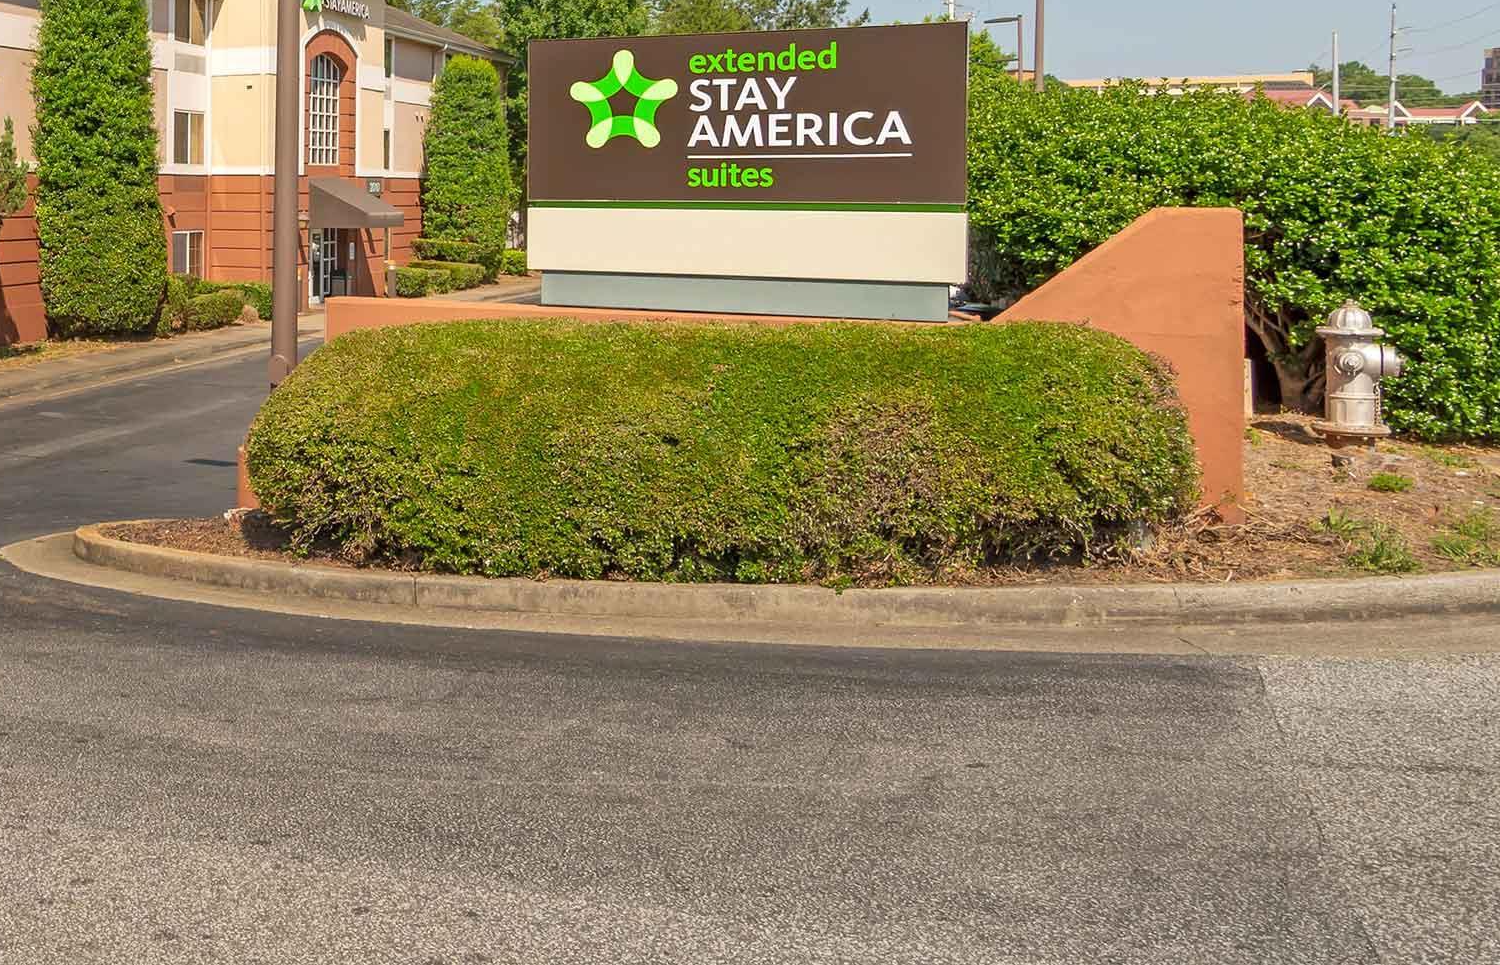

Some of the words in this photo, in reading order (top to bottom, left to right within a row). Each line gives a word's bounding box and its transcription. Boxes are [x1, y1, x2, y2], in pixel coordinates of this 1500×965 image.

[689, 41, 837, 74] extended
[689, 76, 797, 111] STAY
[687, 111, 912, 148] AMERICA
[687, 162, 774, 188] suites
